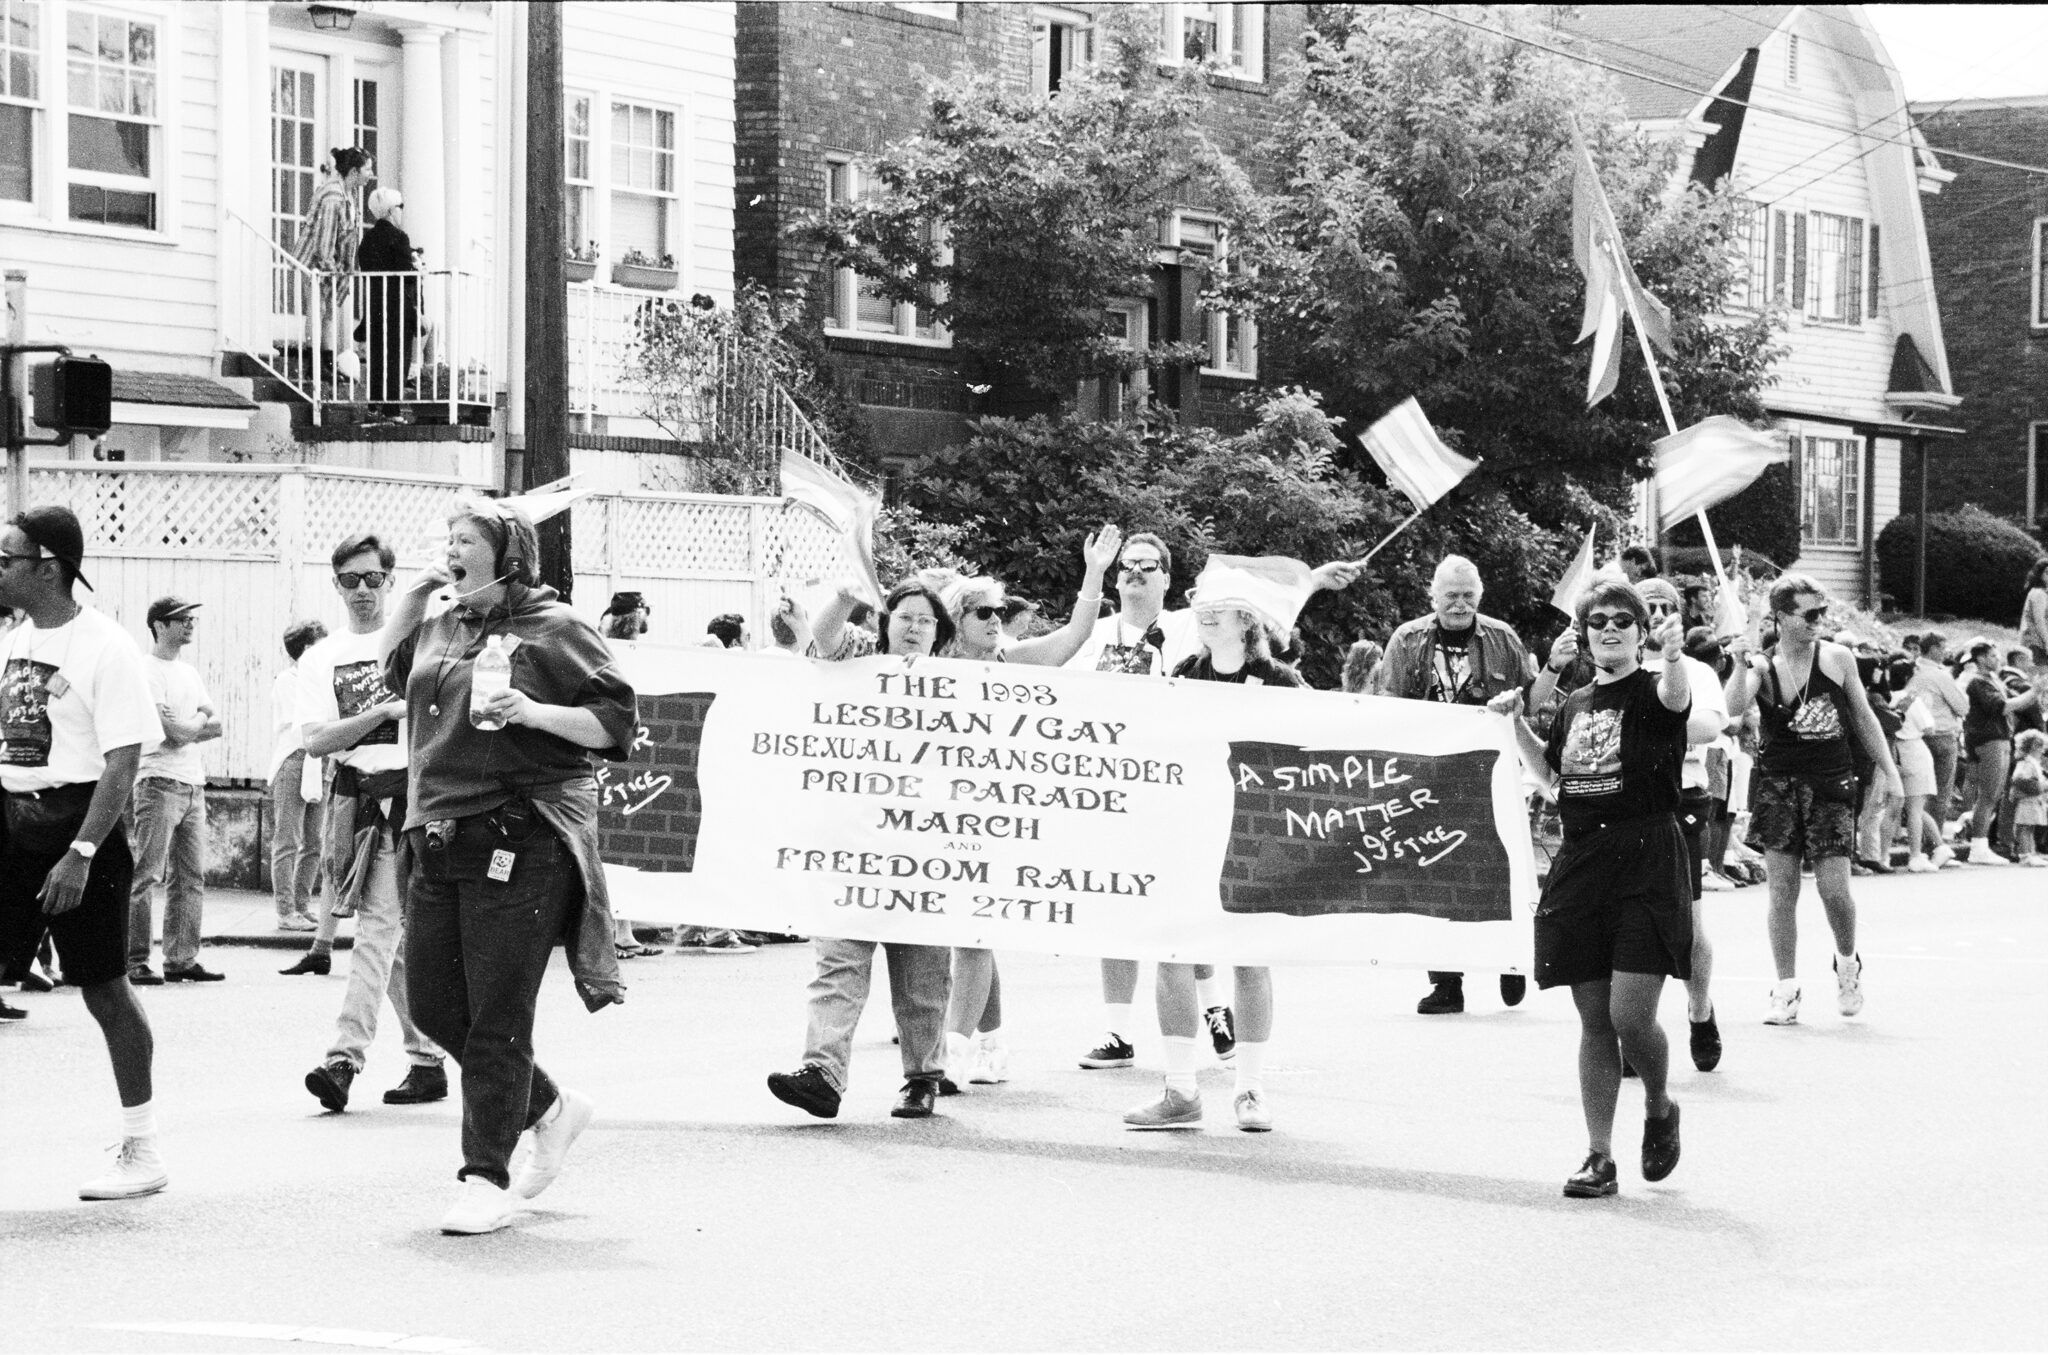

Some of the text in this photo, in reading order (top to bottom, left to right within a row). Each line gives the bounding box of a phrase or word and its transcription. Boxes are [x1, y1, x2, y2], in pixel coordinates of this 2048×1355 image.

[876, 673, 1057, 705] THE 1993
[603, 770, 663, 808] STICE
[803, 769, 1127, 813] PRIDE PARADE
[1236, 756, 1412, 791] A SIMPLE
[877, 808, 1039, 840] MARCH
[1285, 788, 1439, 840] MATTER
[944, 841, 982, 851] AND
[1363, 826, 1396, 848] OF
[777, 848, 1155, 896] FREEDOM RALLY
[834, 886, 1073, 924] JUNE 27TH
